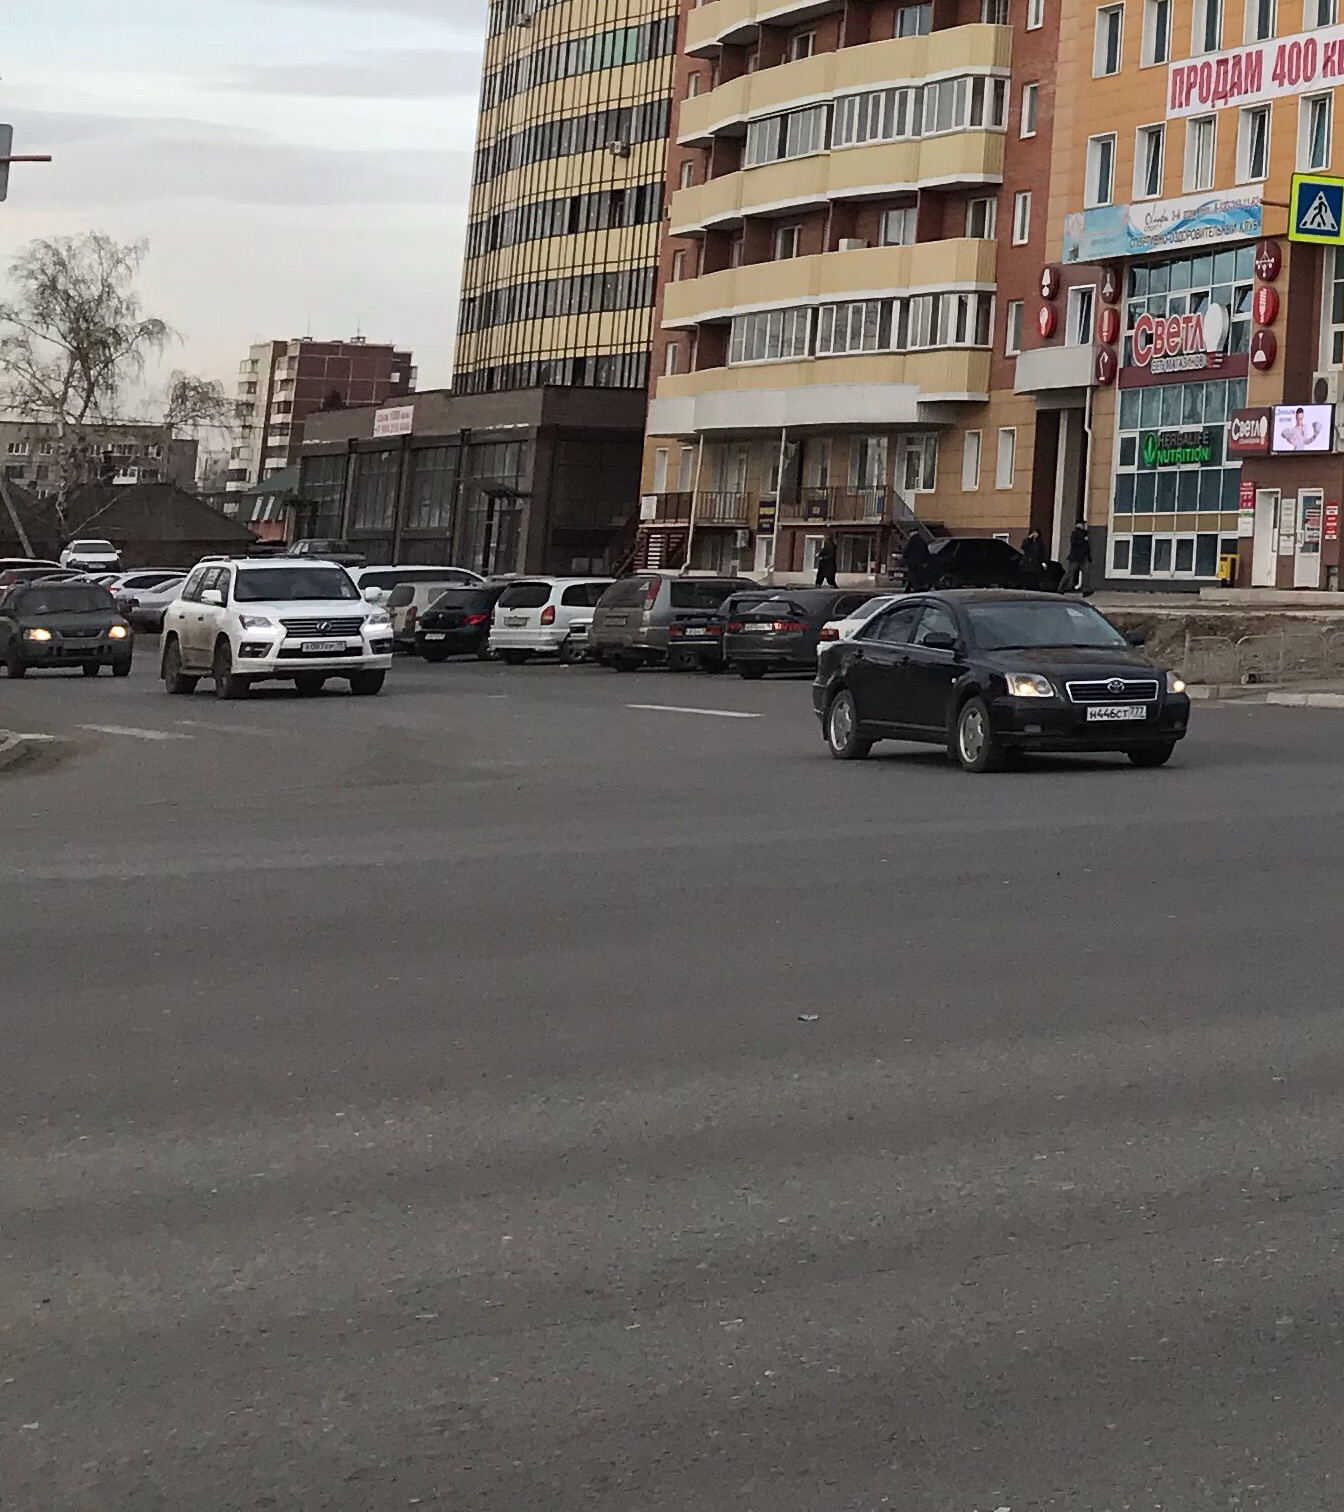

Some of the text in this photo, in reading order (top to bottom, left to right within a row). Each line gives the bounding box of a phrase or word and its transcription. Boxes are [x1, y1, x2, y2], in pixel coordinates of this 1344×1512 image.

[1170, 50, 1263, 108] ПРОДАМ
[1272, 38, 1316, 87] 400
[1157, 449, 1210, 464] NUTRITION
[1089, 708, 1129, 719] Н446СТ
